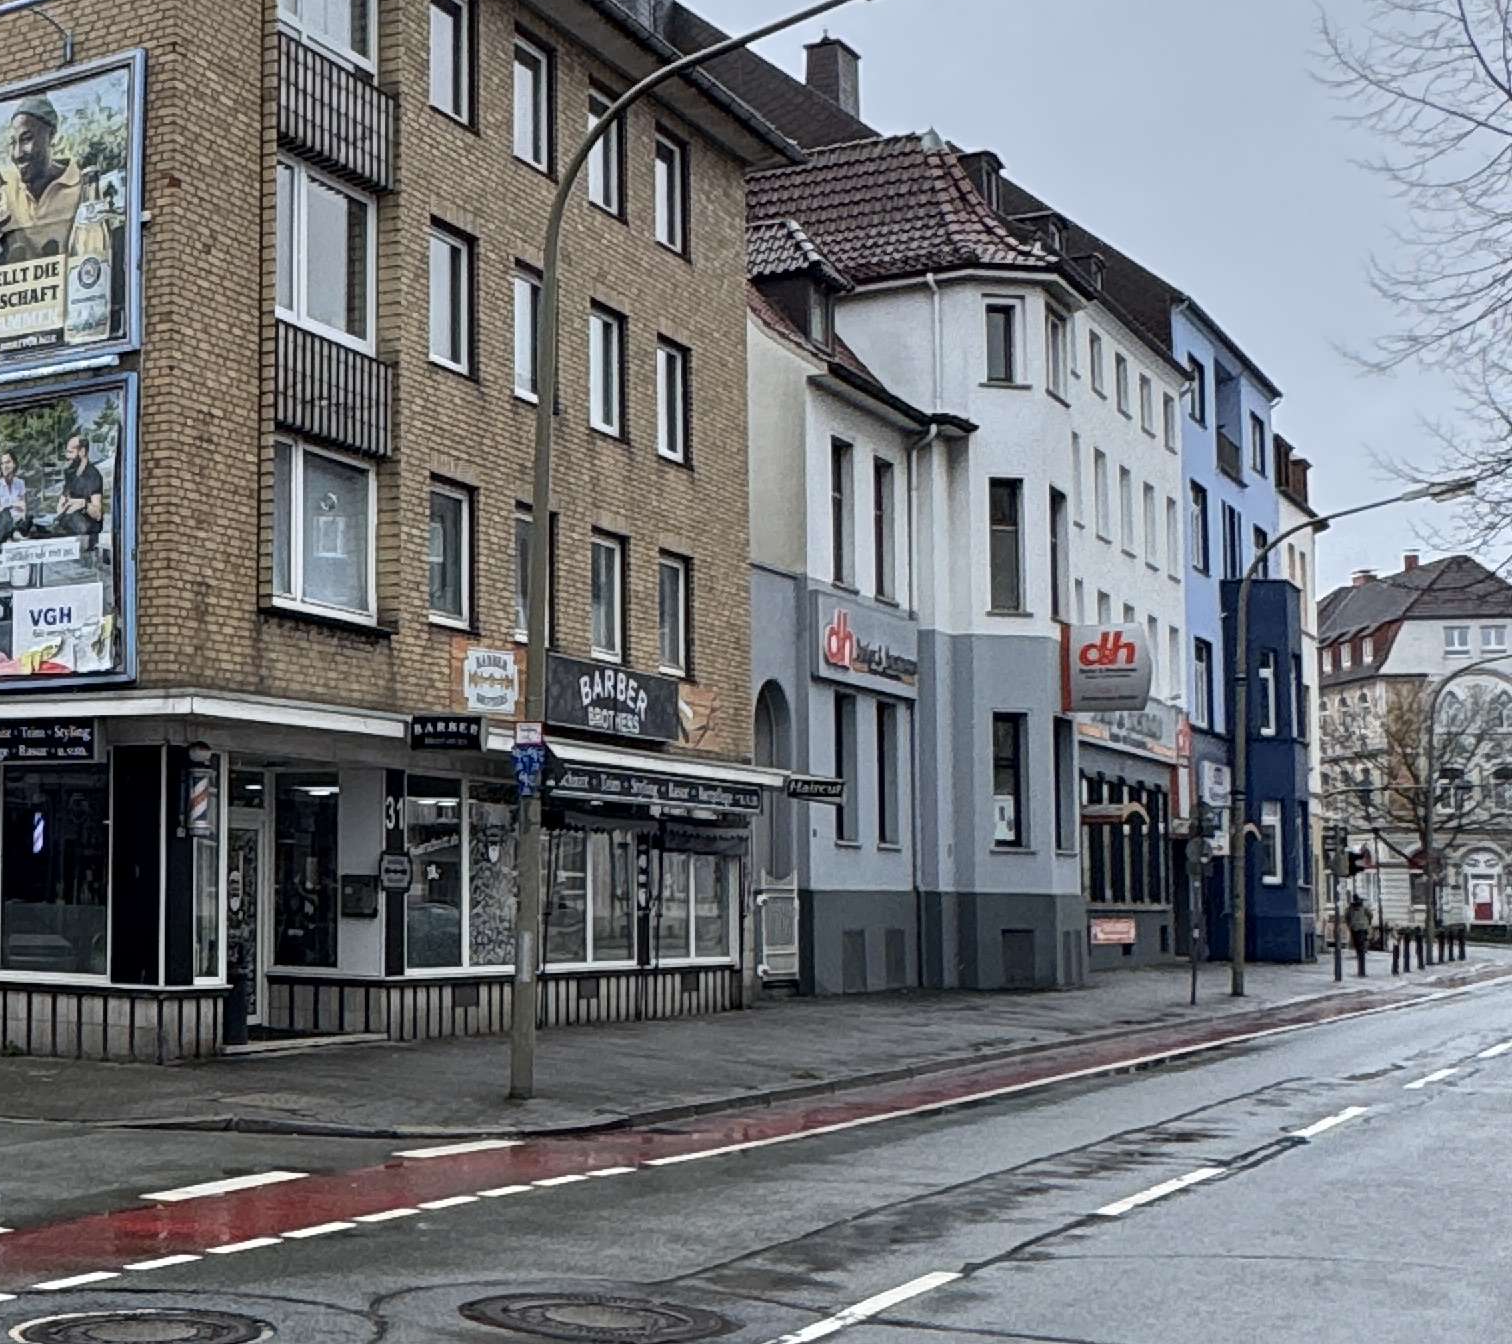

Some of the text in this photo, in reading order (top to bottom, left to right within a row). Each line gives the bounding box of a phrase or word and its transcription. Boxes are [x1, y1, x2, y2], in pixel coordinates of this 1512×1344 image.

[33, 260, 60, 280] DIE
[29, 606, 72, 627] VGH
[579, 668, 648, 722] BARBER
[414, 721, 479, 736] BARBER
[588, 706, 640, 734] BROTHERS
[385, 796, 404, 830] 31
